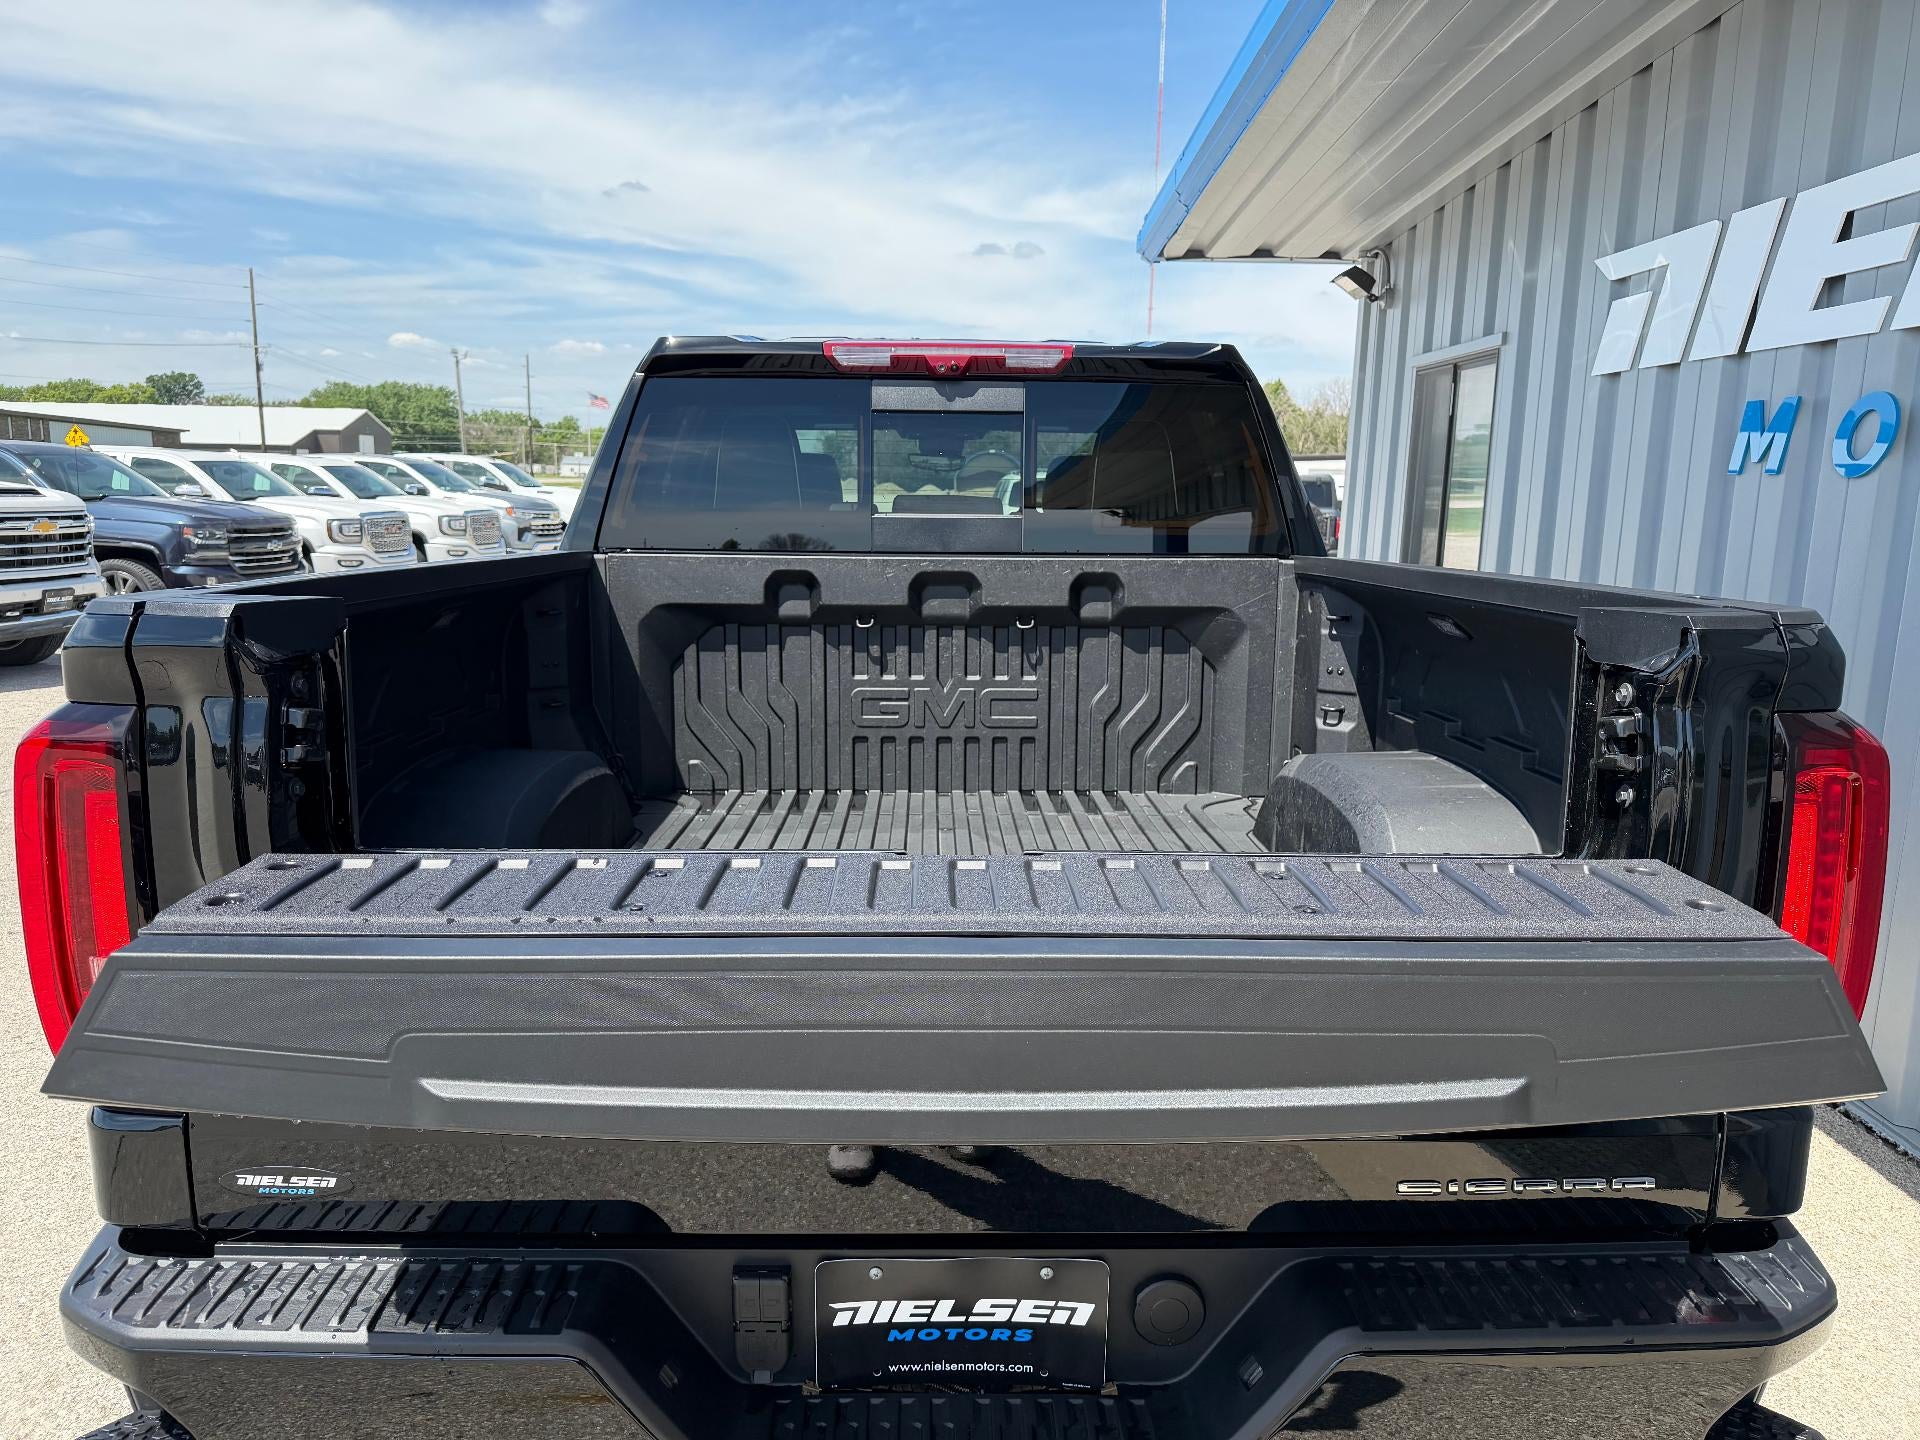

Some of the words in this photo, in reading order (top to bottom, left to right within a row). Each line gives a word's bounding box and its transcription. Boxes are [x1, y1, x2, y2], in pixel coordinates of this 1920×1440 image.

[1591, 152, 1920, 376] NIE
[851, 687, 1038, 729] GMC
[235, 1174, 338, 1188] NIELSEN
[1396, 1176, 1657, 1196] SIERRA
[258, 1187, 315, 1195] MOTORS
[828, 1299, 1096, 1327] NIELSEN
[887, 1328, 1034, 1343] MOTORS
[888, 1359, 1034, 1374] www.nielsenmotors.com
